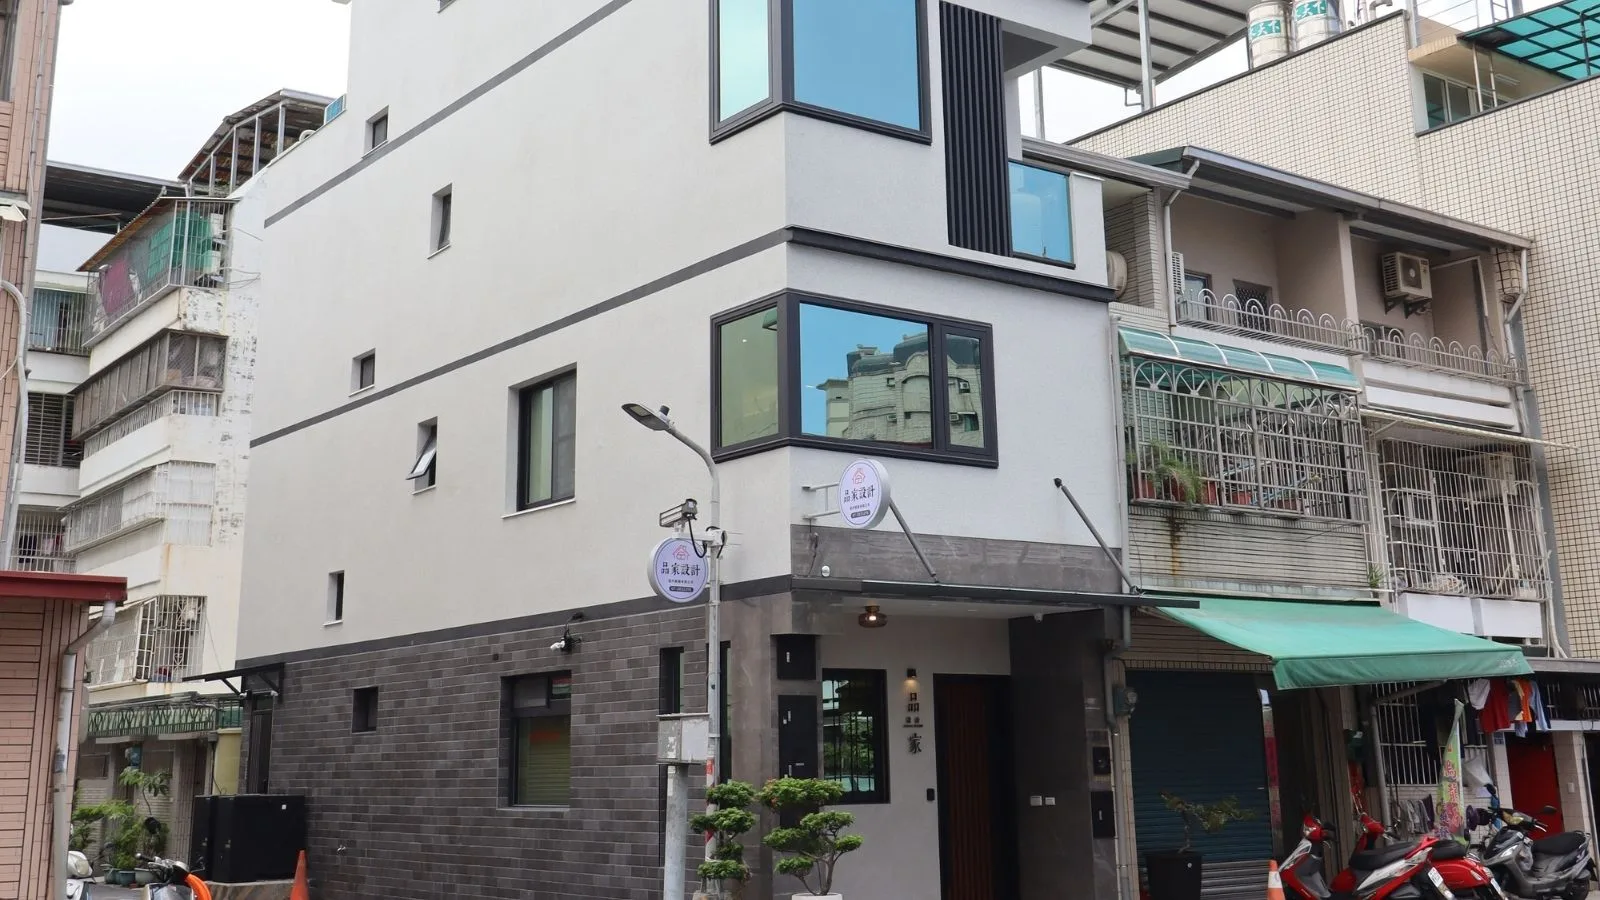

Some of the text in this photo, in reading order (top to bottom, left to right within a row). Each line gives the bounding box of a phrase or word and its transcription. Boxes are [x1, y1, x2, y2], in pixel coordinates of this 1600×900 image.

[843, 485, 875, 504] 品家設計
[660, 561, 701, 576] 品家設計
